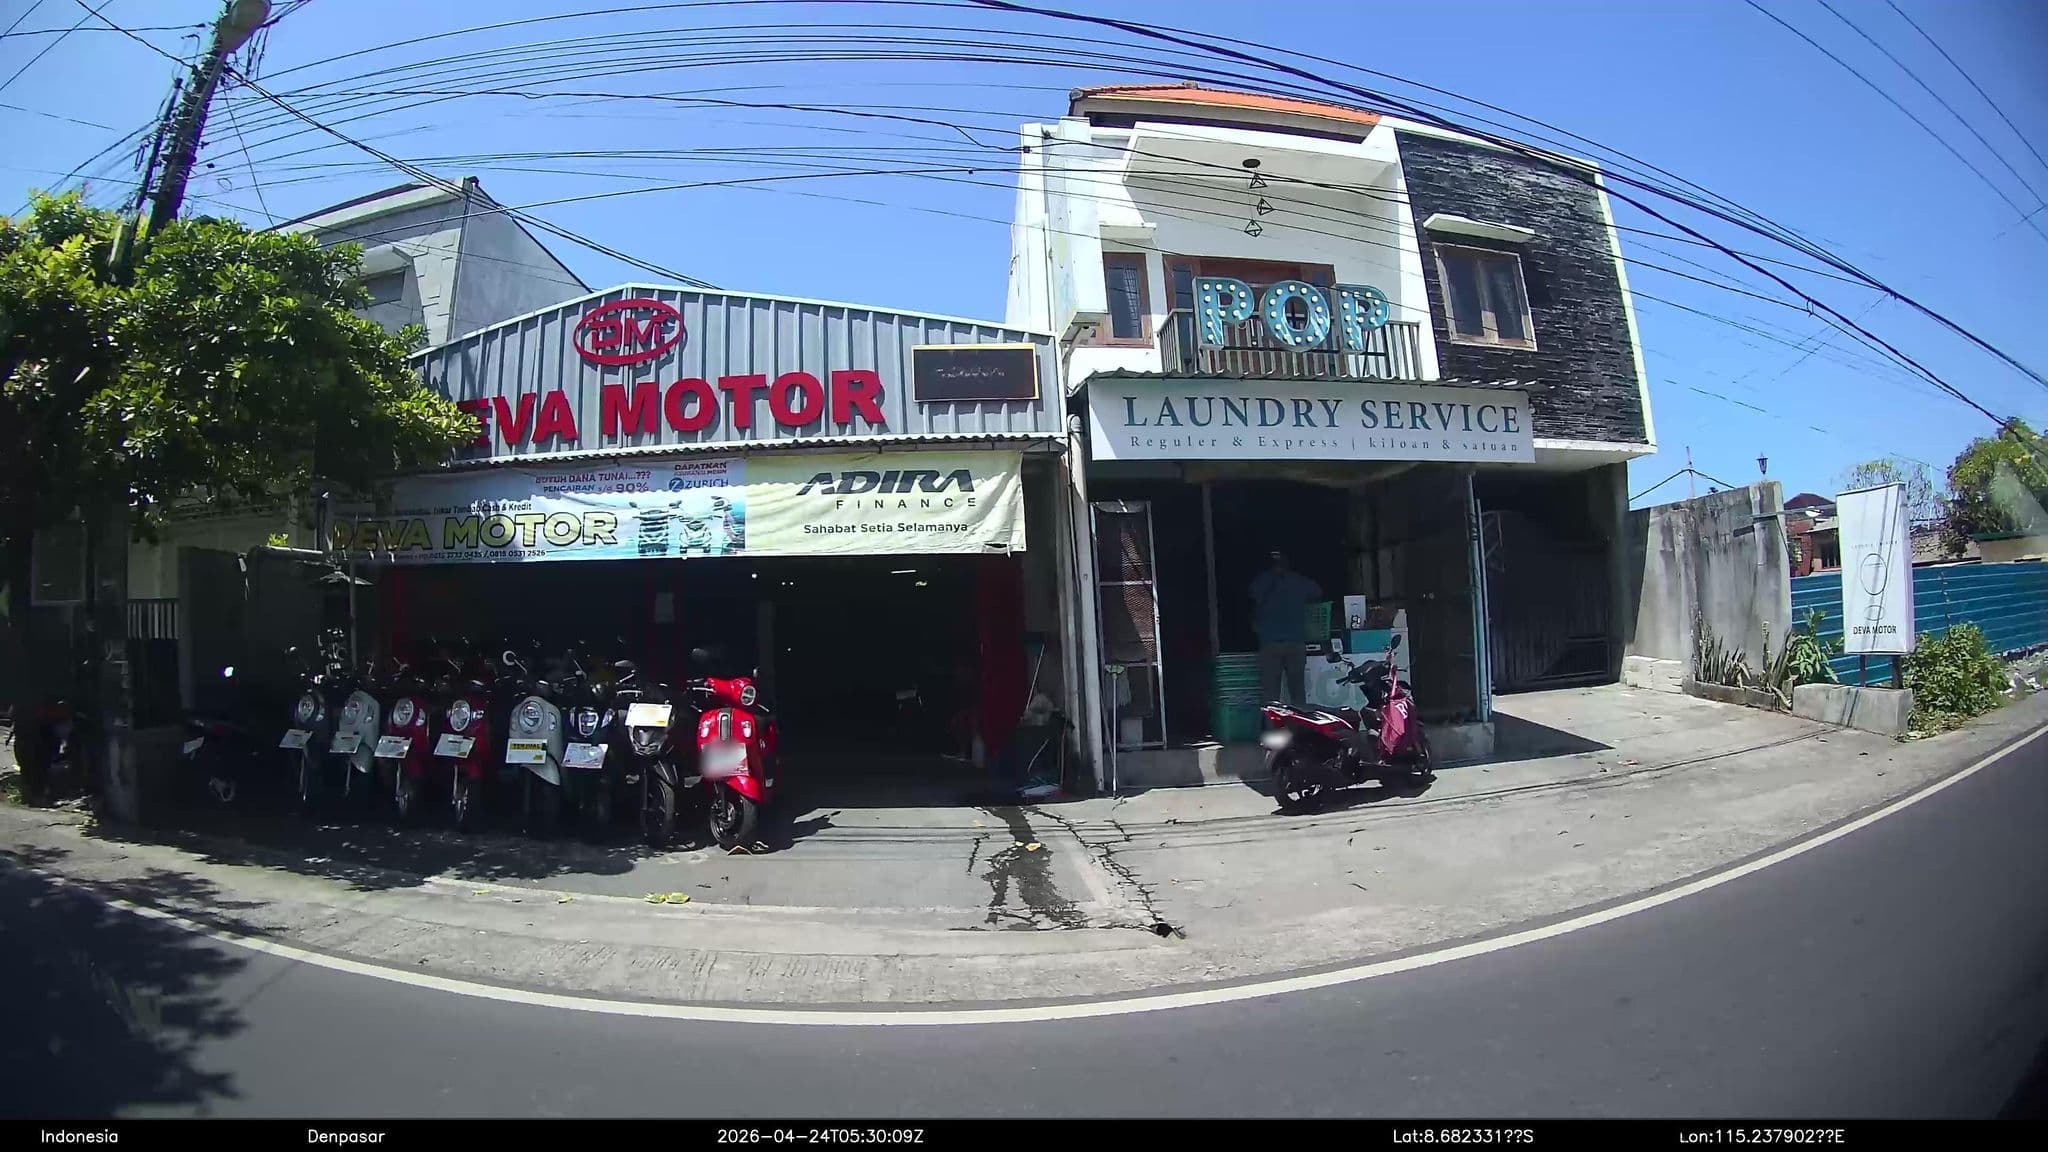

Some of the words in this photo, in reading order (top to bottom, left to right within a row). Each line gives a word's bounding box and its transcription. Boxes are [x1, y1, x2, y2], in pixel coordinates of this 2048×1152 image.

[1193, 276, 1390, 352] POP
[457, 390, 578, 448] EVA
[603, 370, 887, 436] MOTOR
[1123, 396, 1342, 427] LAUNDRY
[1360, 400, 1520, 433] SERVICE
[1130, 435, 1216, 449] Reguler
[1232, 436, 1242, 447] &
[1258, 436, 1338, 450] Express
[1369, 437, 1430, 449] kiloan
[1442, 439, 1451, 449] &
[1463, 439, 1518, 451] satuan
[674, 461, 727, 471] DAPATKAN
[535, 475, 567, 485] BUTUH
[569, 474, 596, 483] DANA
[685, 478, 729, 490] ZURICH
[796, 469, 975, 495] ADIRA
[543, 484, 594, 493] PENCAIRAN
[616, 482, 649, 493] 90%
[482, 502, 500, 513] Cash
[502, 502, 507, 512] &
[508, 502, 532, 511] Kredit
[836, 497, 976, 510] FINANCE
[333, 518, 432, 551] DEVA
[444, 510, 617, 550] MOTOR
[804, 524, 856, 534] Sahabat
[860, 522, 893, 533] Setia
[897, 522, 968, 534] Selamanya
[1853, 625, 1871, 635] DEVA
[1872, 625, 1897, 635] MOTOR
